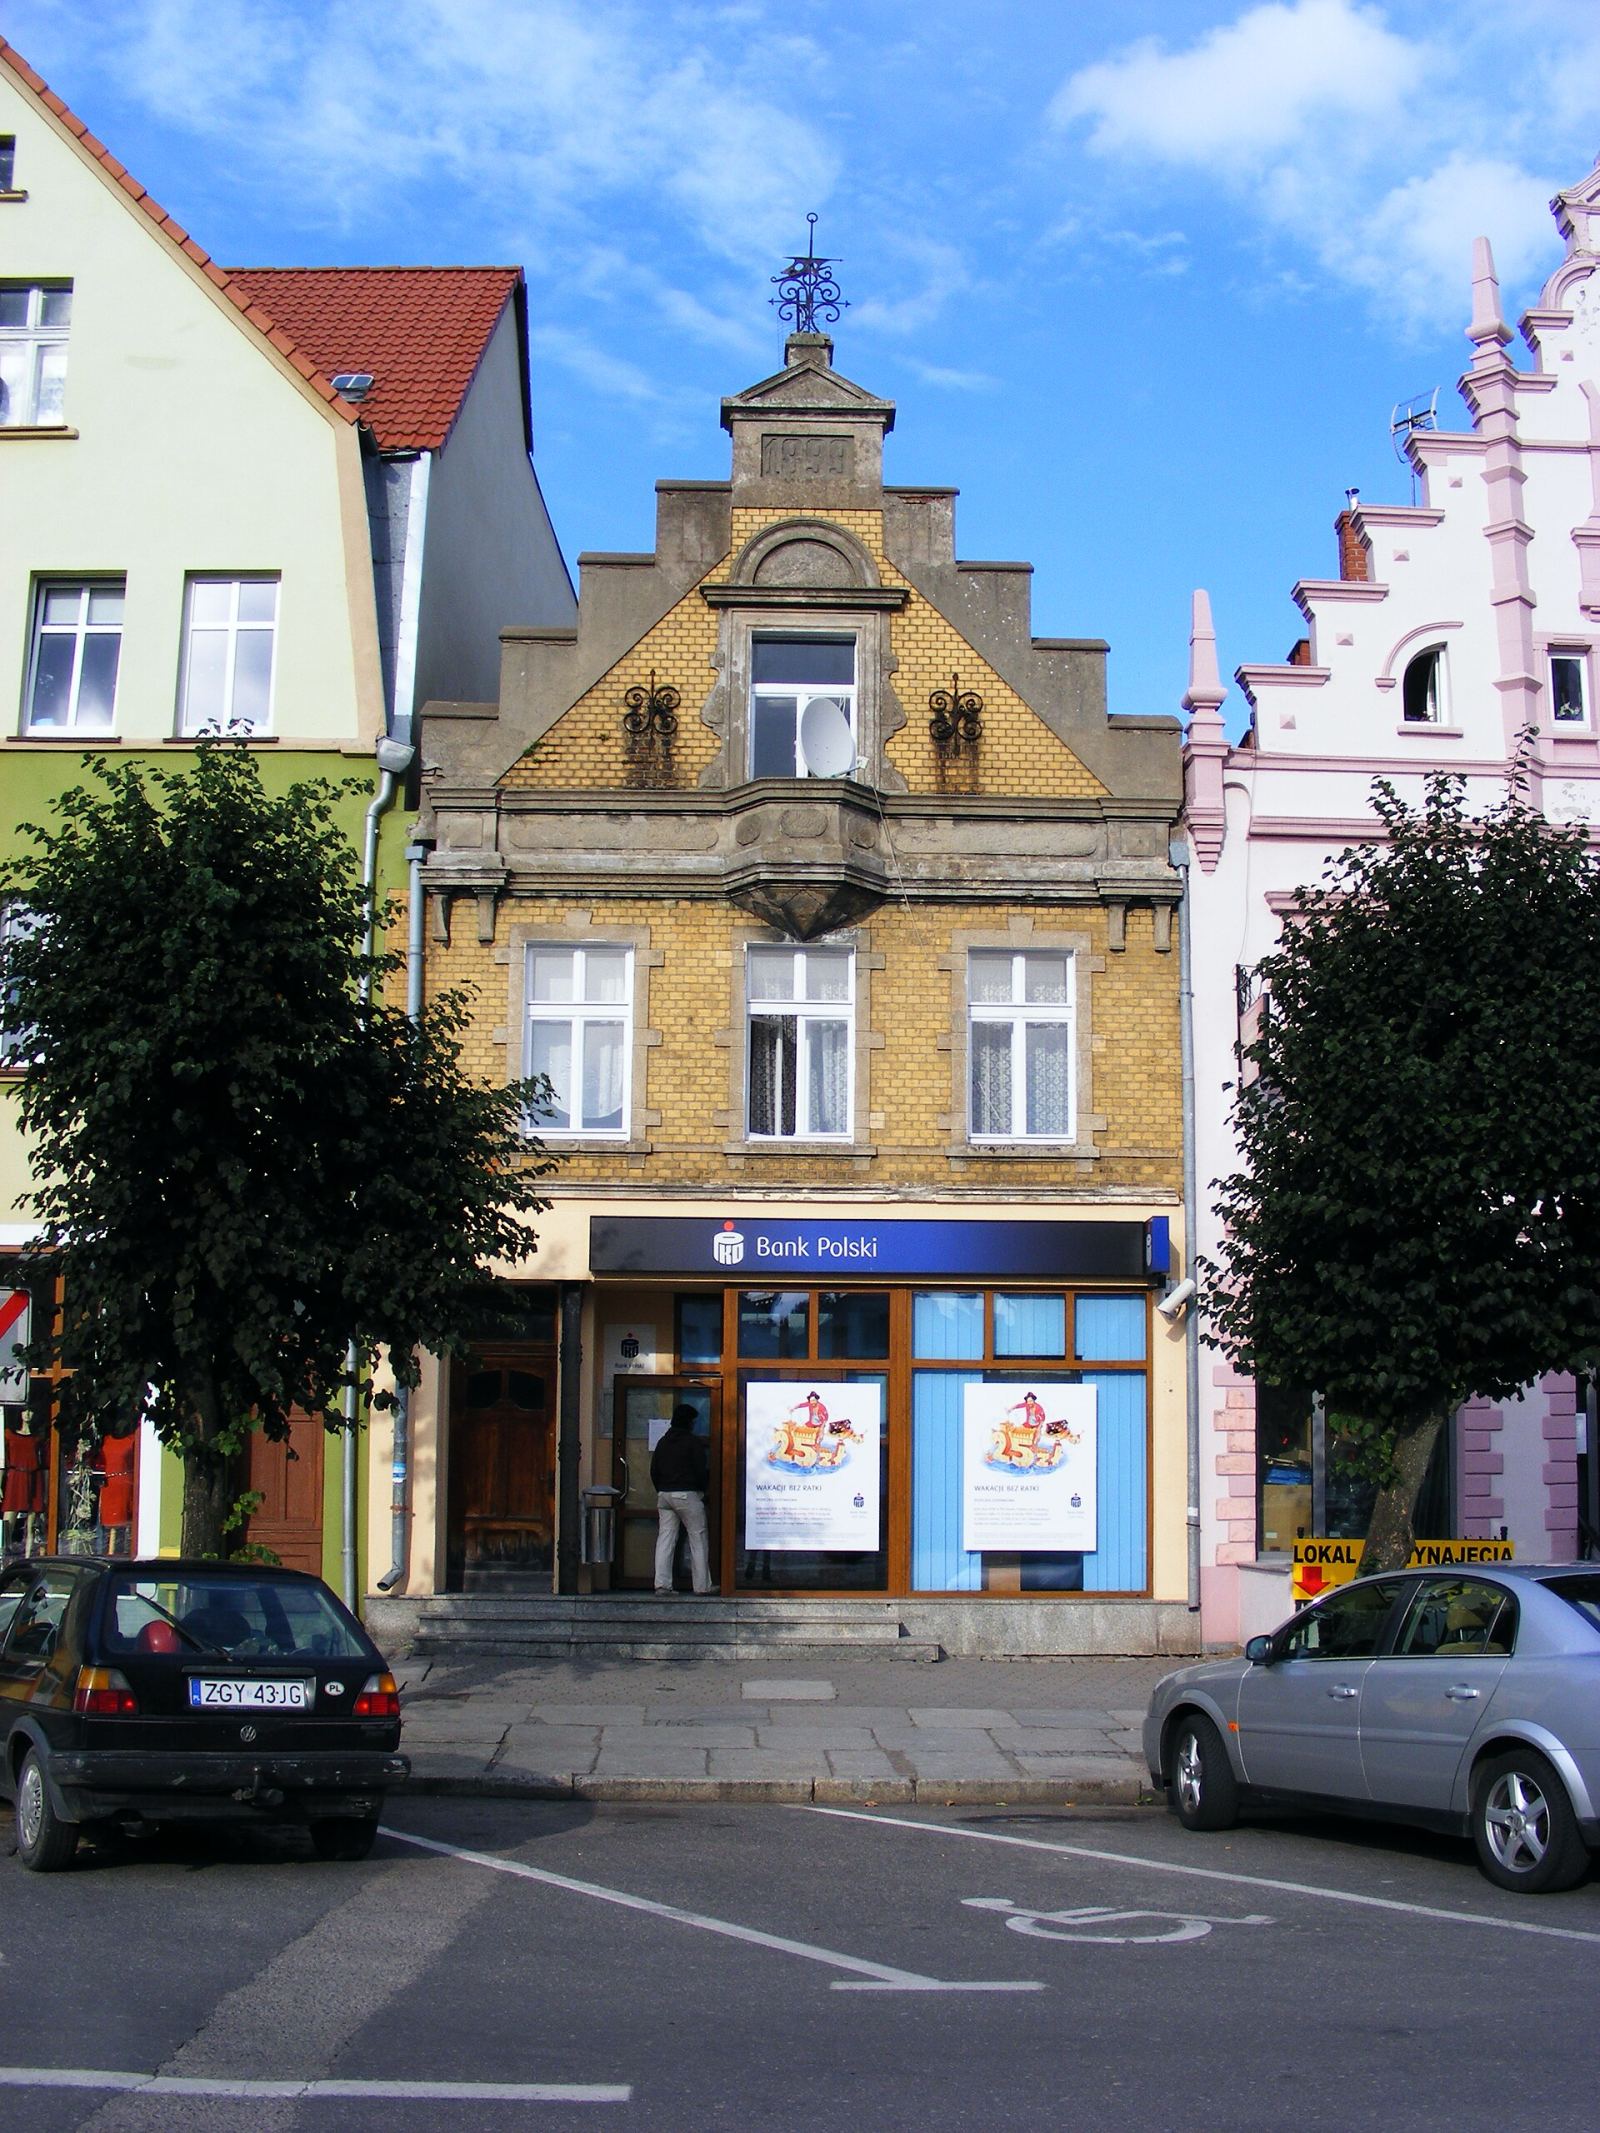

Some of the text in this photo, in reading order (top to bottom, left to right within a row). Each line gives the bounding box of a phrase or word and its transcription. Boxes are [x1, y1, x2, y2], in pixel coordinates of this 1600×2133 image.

[757, 1236, 809, 1257] Bank
[818, 1237, 878, 1258] Polski
[771, 1429, 818, 1467] 25
[990, 1430, 1035, 1468] 25
[974, 1485, 1004, 1493] WAKACJE
[1293, 1544, 1357, 1564] LOKAL
[204, 1682, 245, 1703] ZGY
[254, 1684, 302, 1704] 43JG
[329, 1684, 342, 1693] PL
